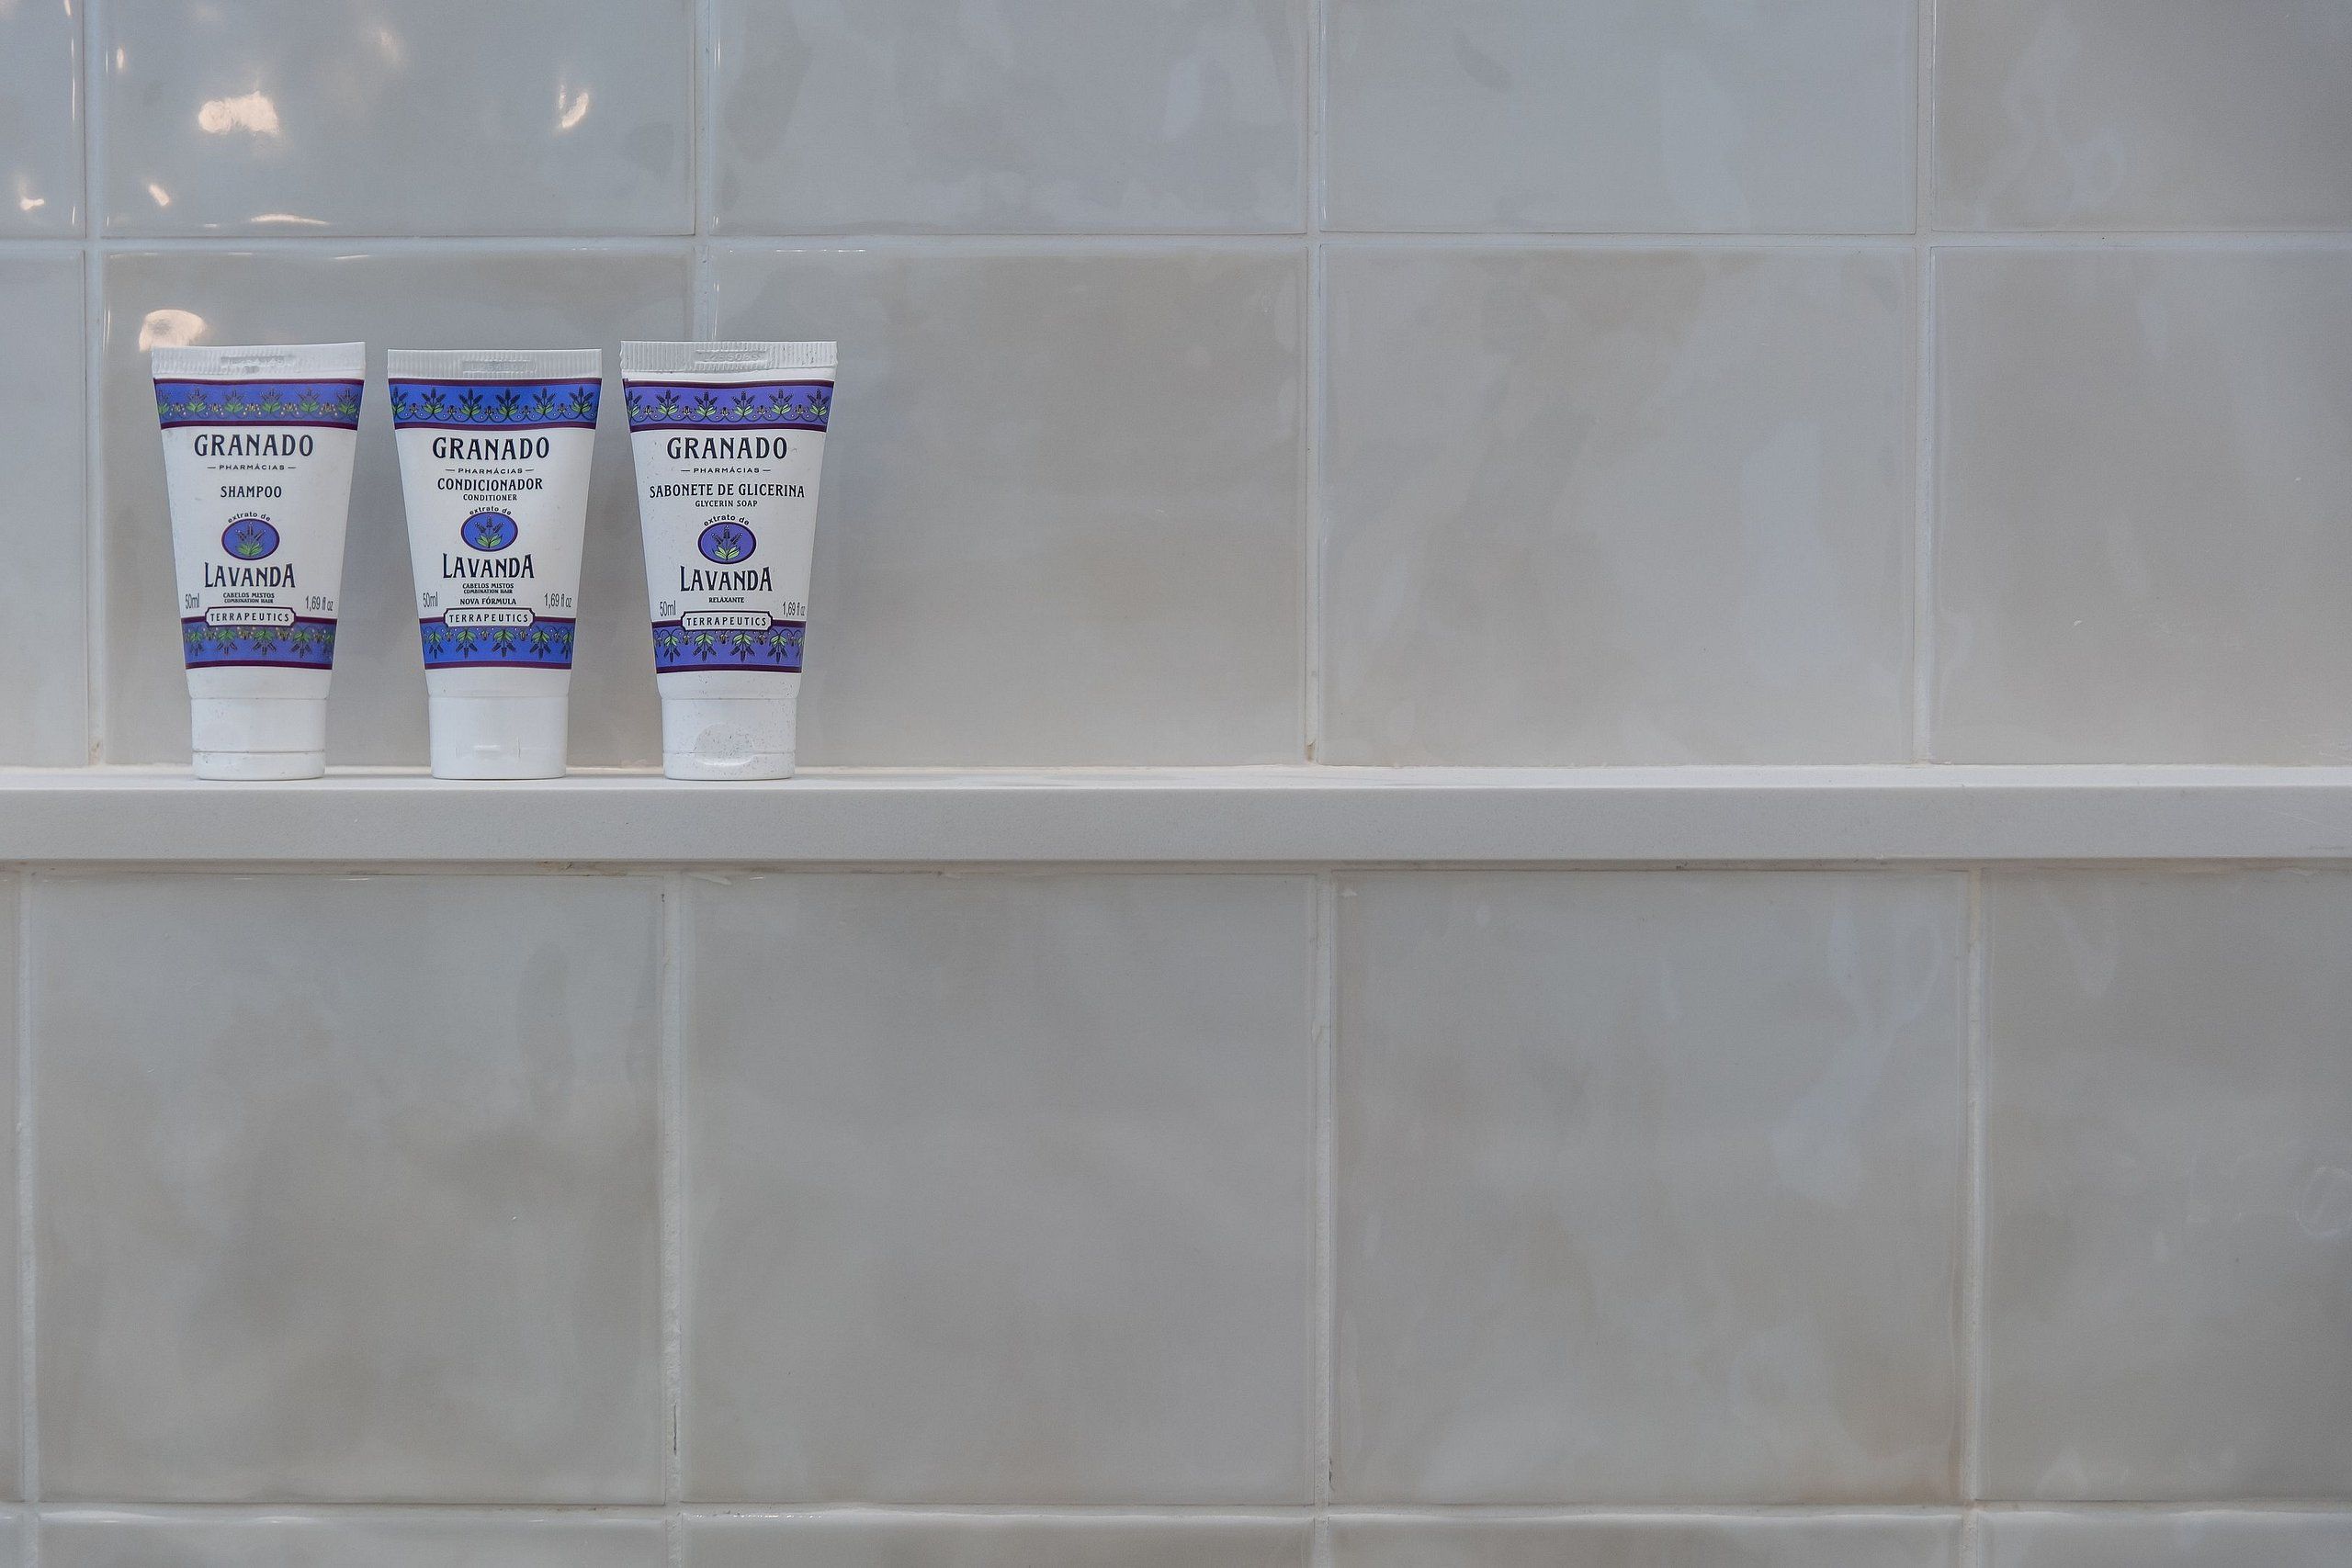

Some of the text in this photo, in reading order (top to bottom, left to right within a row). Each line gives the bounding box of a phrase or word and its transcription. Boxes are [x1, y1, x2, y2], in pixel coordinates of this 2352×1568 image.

[194, 434, 314, 457] GRANADO
[432, 436, 549, 460] GRANADO
[666, 436, 787, 459] GRANADO
[458, 467, 523, 475] PHARMÁCIAS
[220, 485, 282, 498] SHAMPOO
[437, 478, 543, 491] CONDICIONADOR
[650, 483, 805, 498] SABONETE DE GLICERINA
[462, 493, 517, 502] CONDITIONER
[228, 511, 271, 524] extrato de
[469, 505, 512, 516] extrato de
[703, 513, 750, 526] extrato de
[442, 552, 535, 579] LAVANDA
[204, 561, 296, 588] LAVANDA
[680, 565, 773, 592] LAVANDA
[185, 592, 200, 610] 50ml
[305, 595, 321, 612] 1,69
[423, 591, 438, 608] 50ml
[459, 596, 516, 605] NOVA FÓRMULA
[544, 592, 560, 609] 1,69
[659, 600, 676, 617] 50ml
[782, 601, 796, 617] 1,69
[210, 612, 289, 622] TERRAPEUTICS
[448, 613, 528, 623] TERRAPEUTICS
[686, 616, 766, 626] TERRAPEUTICS
